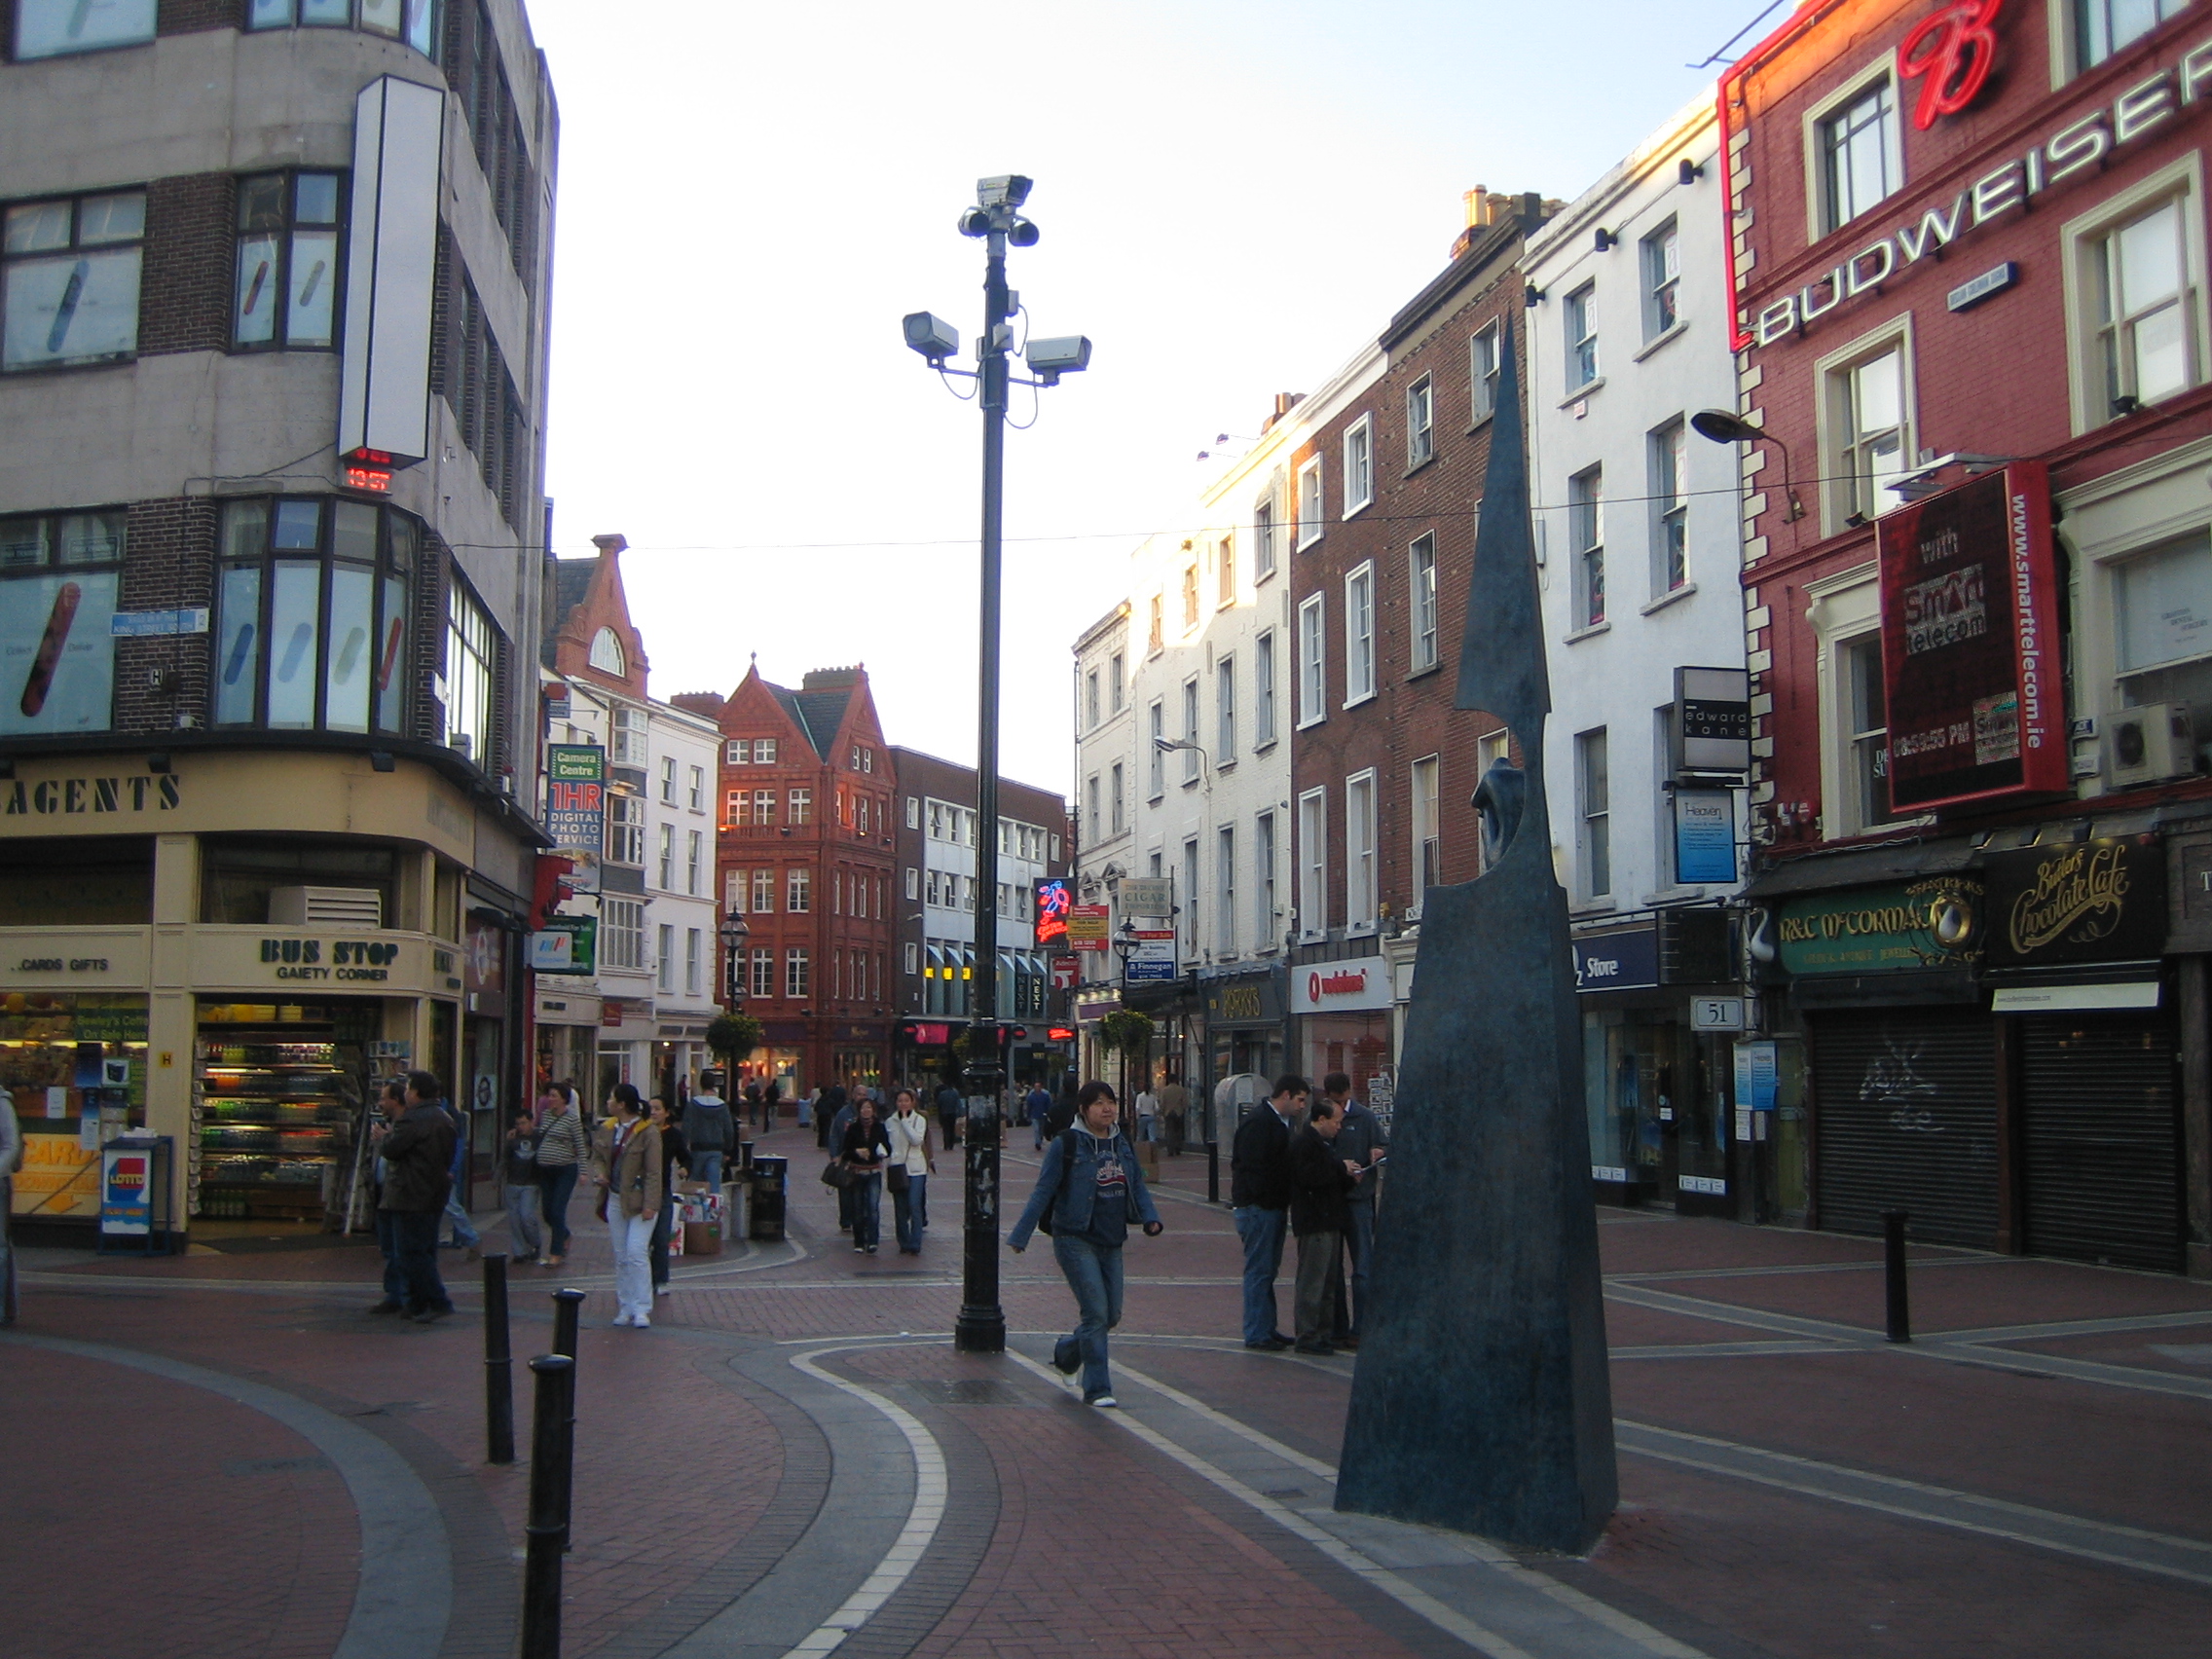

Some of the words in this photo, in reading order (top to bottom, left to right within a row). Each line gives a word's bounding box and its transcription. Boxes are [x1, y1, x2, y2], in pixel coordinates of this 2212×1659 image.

[1920, 529, 1958, 565] with
[2011, 493, 2045, 750] www.smarttelecom.ie
[1907, 614, 1985, 651] telecom
[1685, 711, 1747, 723] edward
[1685, 724, 1747, 736] kane
[557, 753, 597, 763] Camera
[560, 765, 594, 776] Centre
[7, 774, 181, 814] AGENTS
[551, 782, 602, 812] 1HR
[551, 812, 599, 823] DIGITAL
[551, 824, 599, 834] PHOTO
[1124, 892, 1165, 902] CIGAR
[2010, 875, 2089, 954] Chocolate
[1780, 915, 1818, 942] R&C
[1822, 903, 1943, 940] McCORMAC
[261, 940, 320, 964] BUS
[334, 941, 399, 965] STOP
[70, 959, 109, 971] GIFTS
[1138, 963, 1172, 972] Finnegan
[1587, 957, 1619, 978] Store
[277, 966, 331, 979] GAIETY
[336, 968, 388, 981] CORNER
[1016, 976, 1026, 1010] NEXT
[1709, 1003, 1726, 1023] 51
[162, 1054, 171, 1065] H
[108, 1173, 144, 1185] LOTTO
